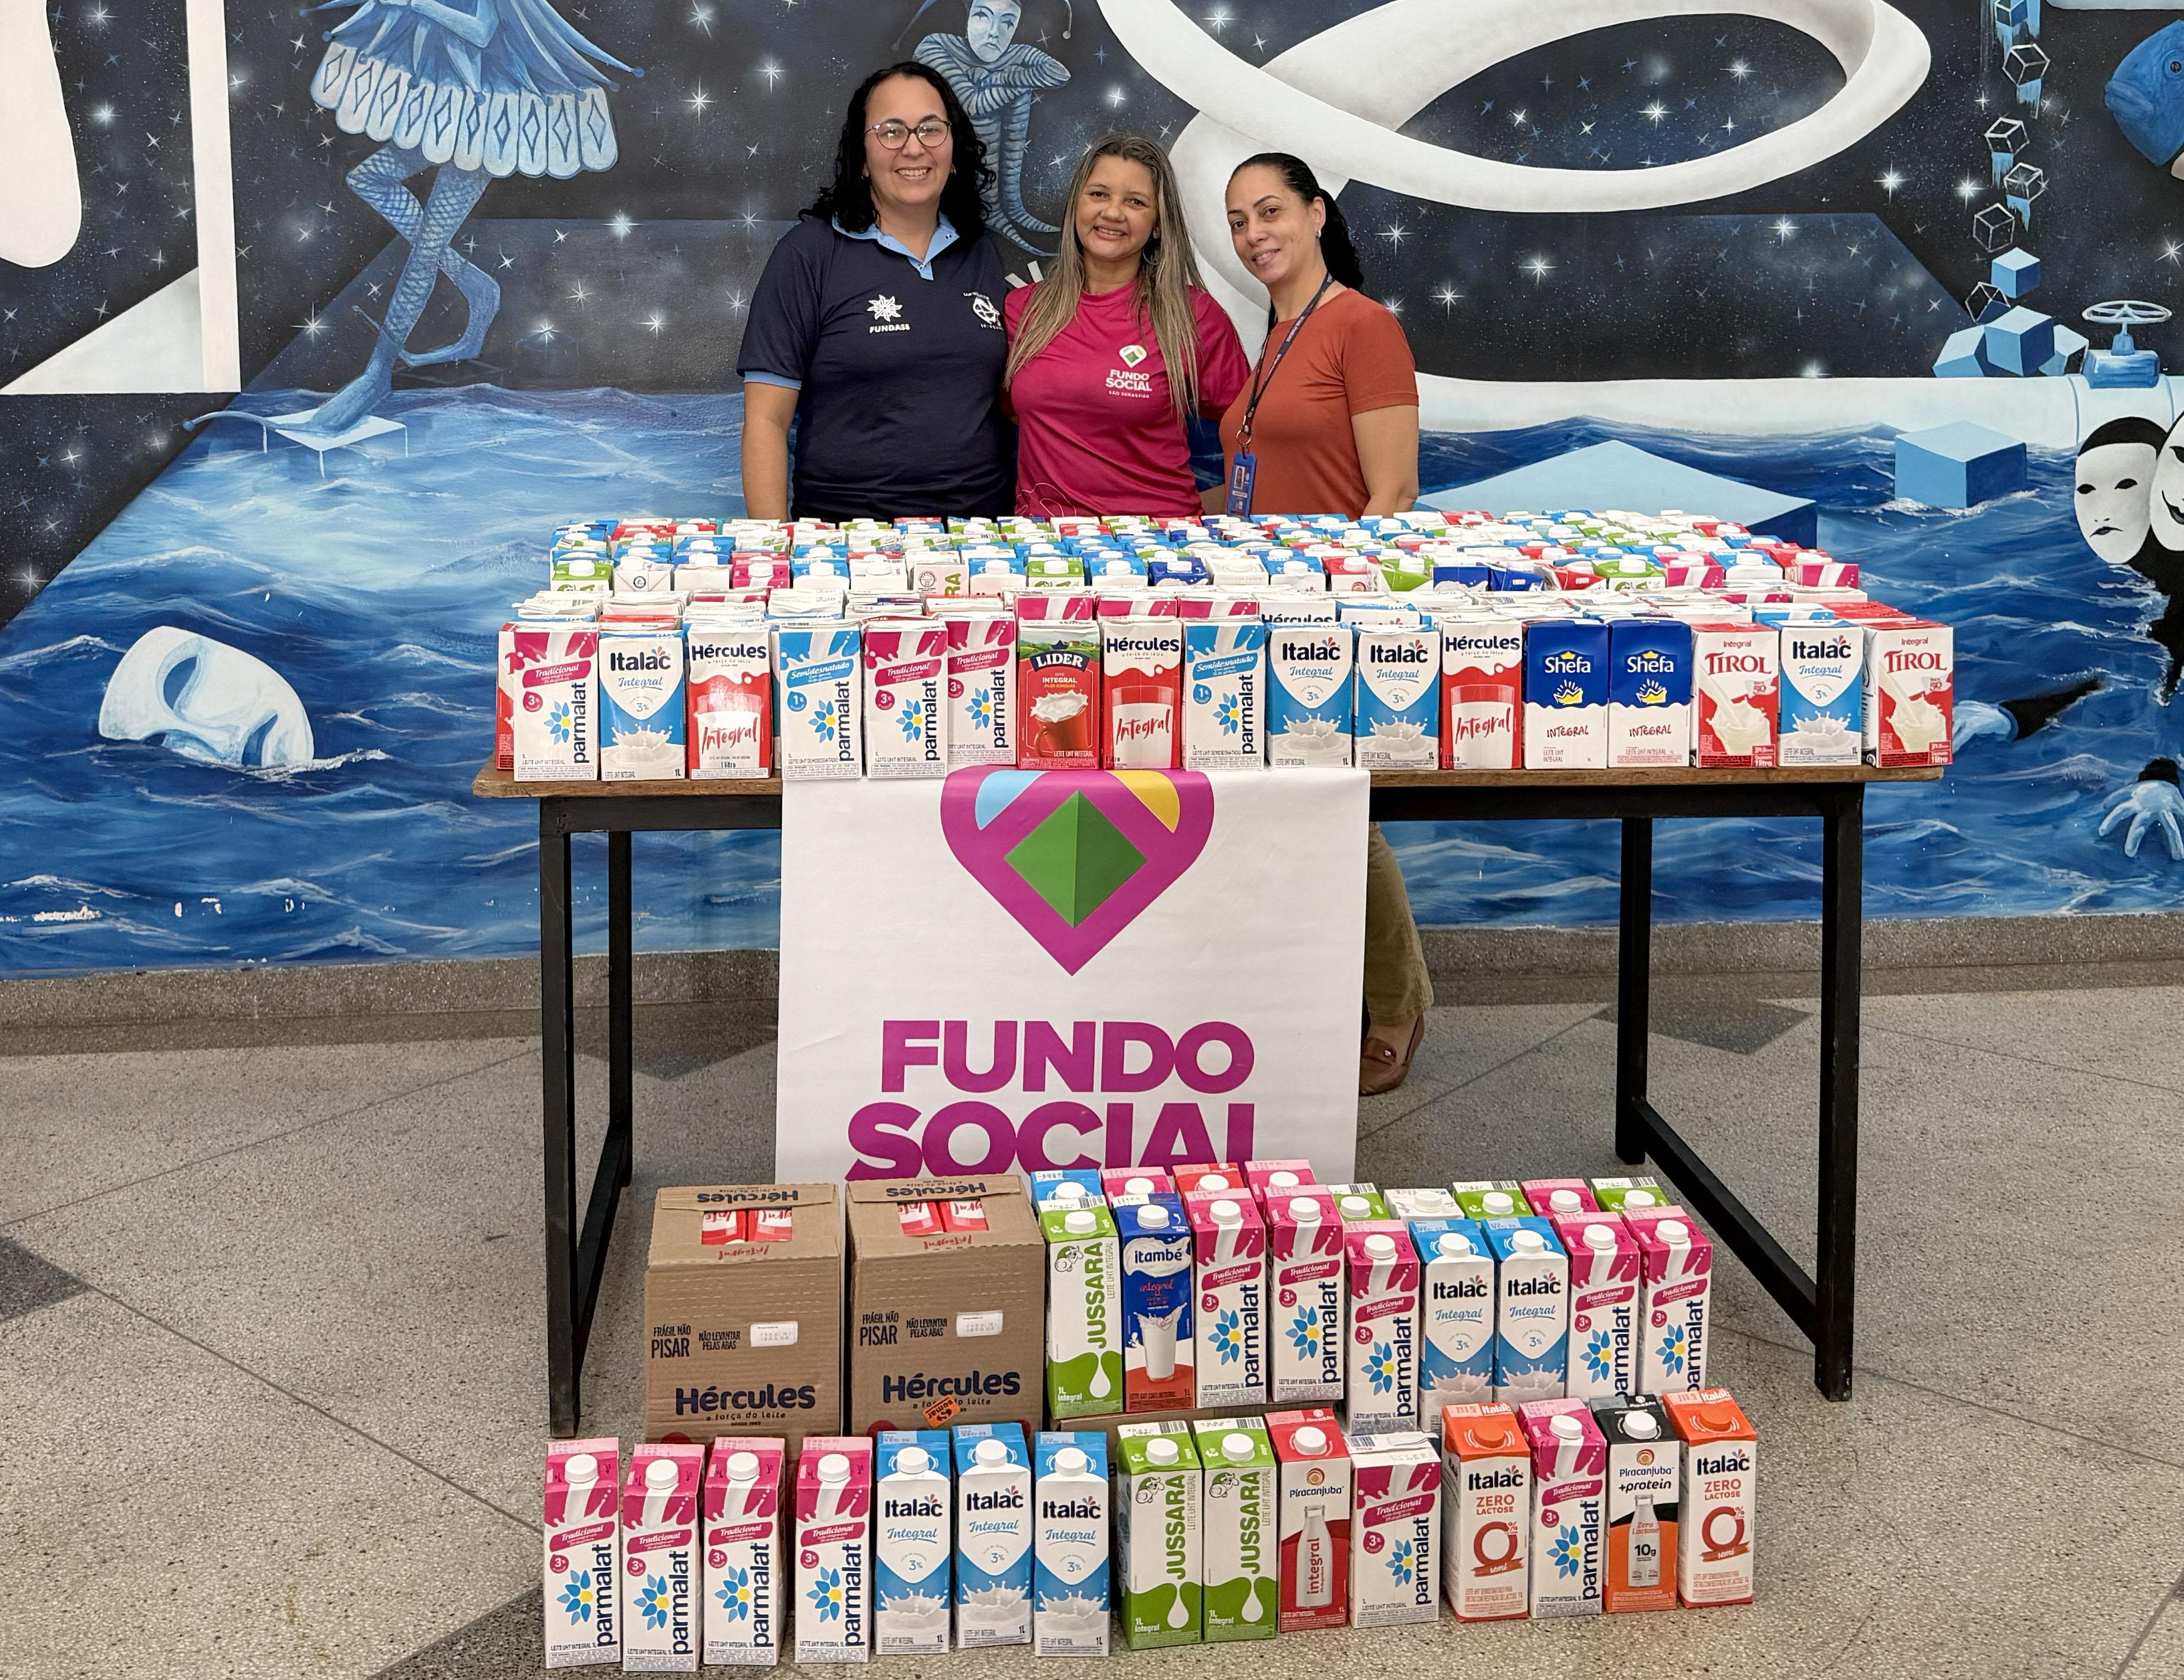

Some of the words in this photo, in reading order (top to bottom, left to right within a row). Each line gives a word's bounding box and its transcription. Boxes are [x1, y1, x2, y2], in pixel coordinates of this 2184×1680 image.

[1110, 369, 1150, 381] FUNDO
[1106, 377, 1153, 391] SOCIAL
[1106, 638, 1179, 653] Hércules
[1282, 642, 1341, 660] Italac
[1446, 636, 1520, 652] Hércules
[1793, 641, 1851, 660] Italac
[692, 644, 766, 660] Hércules
[957, 651, 998, 665] Tradicional
[1370, 645, 1428, 663] Italac
[610, 651, 671, 671] Italac
[1036, 653, 1084, 668] LIDER
[1545, 657, 1591, 673] Shefa
[1627, 656, 1674, 672] Shefa
[1705, 652, 1771, 675] TIROL
[1884, 650, 1947, 673] TIROL
[887, 663, 930, 676] Tradicional
[1290, 667, 1333, 678] Integral
[1377, 669, 1419, 679] Integral
[1799, 665, 1842, 675] Integral
[619, 677, 663, 687] Integral
[1307, 692, 1319, 701] 3%
[1393, 695, 1405, 704] 3%
[636, 703, 649, 711] 3%
[991, 669, 1008, 748] parmalat
[1239, 674, 1257, 755] parmalat
[571, 682, 589, 763] parmalat
[835, 681, 854, 762] parmalat
[922, 680, 940, 761] parmalat
[1116, 709, 1170, 744] Integral
[1456, 708, 1511, 744] Integral
[702, 717, 757, 754] Integral
[1547, 726, 1589, 738] INTEGRAL
[1629, 724, 1672, 737] INTEGRAL
[881, 1020, 1255, 1093] FUNDO
[697, 1190, 798, 1204] Hércules
[886, 1182, 986, 1197] Hércules
[1135, 1249, 1182, 1263] itambé
[1434, 1280, 1487, 1299] Italac
[1508, 1277, 1561, 1296] Italac
[1084, 1242, 1107, 1348] JUSSARA
[862, 1312, 883, 1324] FRÁGIL
[885, 1311, 899, 1323] NÃO
[1435, 1309, 1482, 1320] Integral
[1510, 1306, 1556, 1316] Integral
[654, 1325, 676, 1337] FRÁGIL
[677, 1323, 690, 1335] NÃO
[906, 1318, 918, 1328] NÃO
[699, 1331, 711, 1341] NÃO
[712, 1331, 740, 1341] LEVANTAR
[860, 1325, 897, 1346] PISAR
[910, 1329, 928, 1337] PELAS
[1240, 1284, 1263, 1388] parmalat
[1319, 1281, 1341, 1383] parmalat
[652, 1338, 689, 1358] PISAR
[702, 1342, 720, 1350] PELAS
[1456, 1341, 1469, 1350] 3%
[1530, 1337, 1542, 1347] 3%
[1393, 1316, 1415, 1417] parmalat
[883, 1370, 1020, 1403] Hércules
[676, 1383, 816, 1415] Hércules
[1620, 1467, 1672, 1477] Piracanjuba
[1697, 1455, 1750, 1475] Italac
[1469, 1471, 1524, 1490] Italac
[1619, 1481, 1671, 1493] +protein
[1704, 1479, 1742, 1493] ZERO
[1290, 1487, 1342, 1498] Piracanjuba
[1705, 1491, 1740, 1500] LACTOSE
[885, 1498, 943, 1518] Italac
[967, 1490, 1024, 1511] Italac
[1476, 1494, 1515, 1507] ZERO
[1043, 1500, 1101, 1519] Italac
[1476, 1506, 1514, 1515] LACTOSE
[969, 1519, 1018, 1532] Integral
[1166, 1475, 1186, 1580] JUSSARA
[1240, 1472, 1260, 1574] JUSSARA
[887, 1528, 938, 1541] Integral
[1045, 1529, 1096, 1541] Integral
[991, 1552, 1005, 1563] 3%
[1580, 1500, 1600, 1600] parmalat
[1634, 1544, 1656, 1557] 10g
[909, 1560, 923, 1570] 3%
[1068, 1562, 1081, 1572] 3%
[1307, 1538, 1320, 1595] integral
[1413, 1517, 1432, 1605] parmalat
[592, 1544, 617, 1647] parmalat
[750, 1543, 773, 1647] parmalat
[842, 1543, 865, 1646] parmalat
[668, 1551, 693, 1654] parmalat
[1019, 1625, 1025, 1634] 1L
[937, 1634, 943, 1643] 1L
